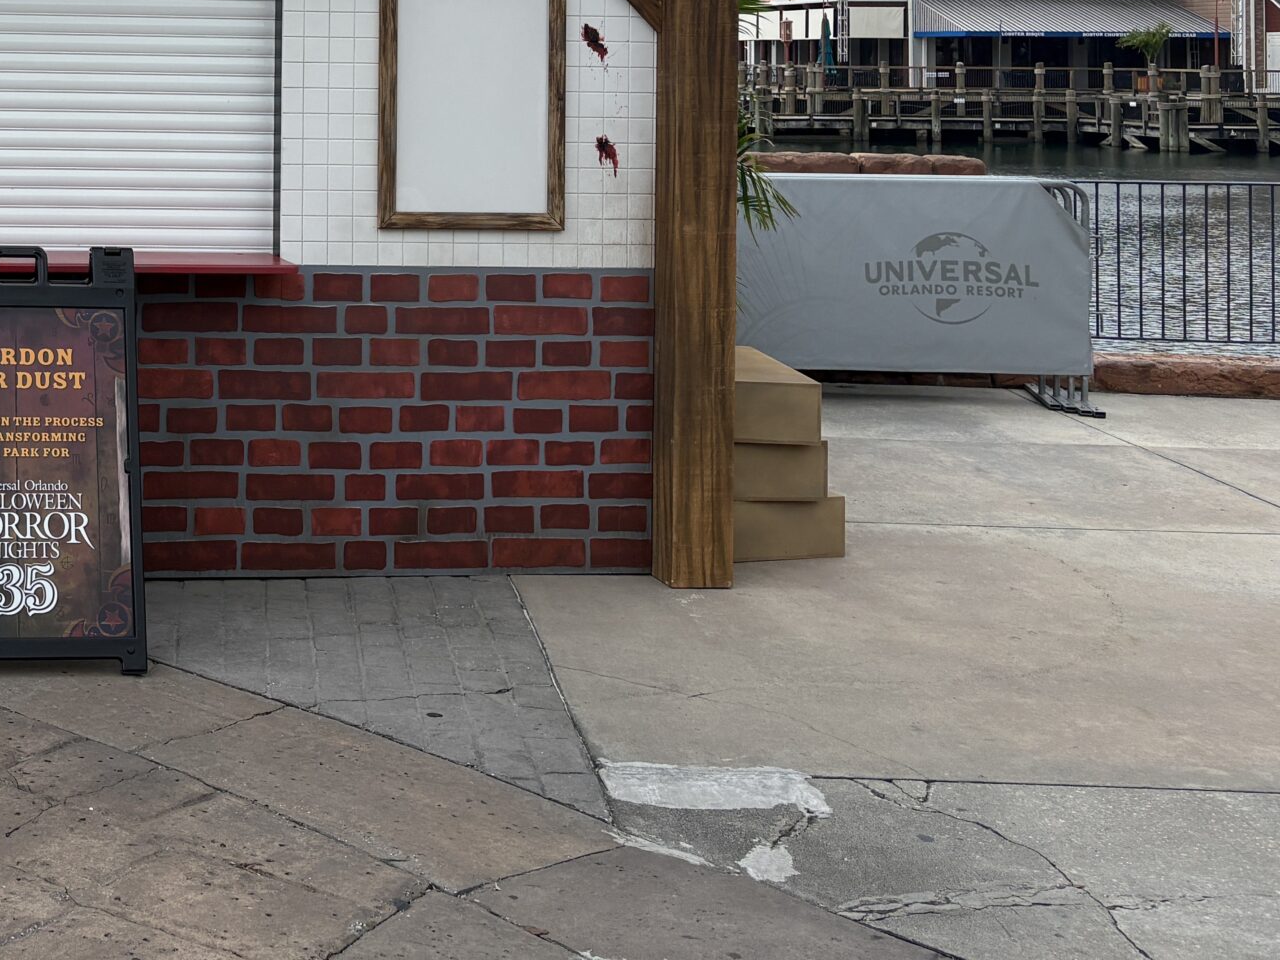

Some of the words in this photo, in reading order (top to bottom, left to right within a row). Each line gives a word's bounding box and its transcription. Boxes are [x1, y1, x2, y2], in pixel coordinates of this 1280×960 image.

[864, 259, 1040, 288] UNIVERSAL
[878, 284, 958, 296] ORLANDO
[966, 285, 1024, 299] RESORT
[16, 371, 86, 389] DUST
[13, 416, 41, 427] THE
[44, 417, 104, 427] PROCESS
[3, 447, 40, 457] PARK
[43, 447, 70, 457] FOR
[24, 479, 68, 491] Orlando
